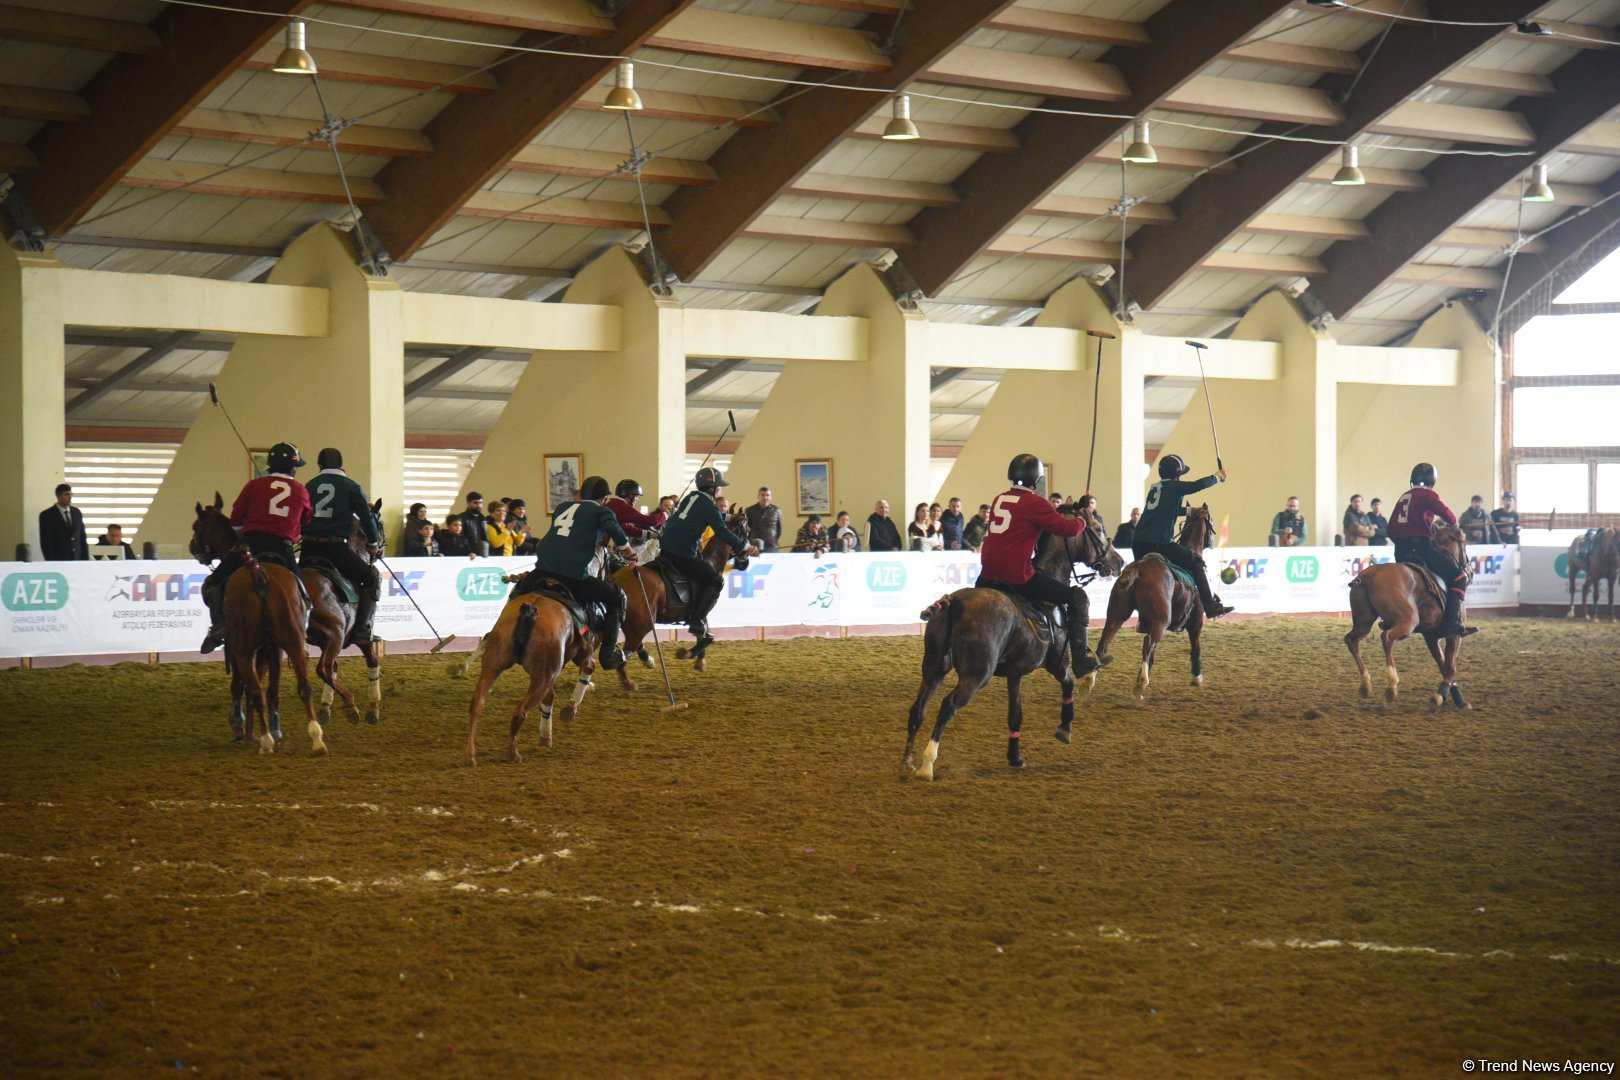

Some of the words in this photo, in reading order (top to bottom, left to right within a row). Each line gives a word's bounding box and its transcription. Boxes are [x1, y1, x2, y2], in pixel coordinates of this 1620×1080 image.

[268, 480, 292, 518] 2
[313, 483, 336, 518] 2
[678, 494, 700, 521] 1
[1147, 482, 1163, 510] 3
[553, 503, 581, 538] 4
[989, 494, 1021, 534] 5
[872, 566, 902, 587] AZE
[1290, 560, 1315, 579] AZE
[12, 579, 58, 605] AZE
[465, 573, 501, 596] AZE
